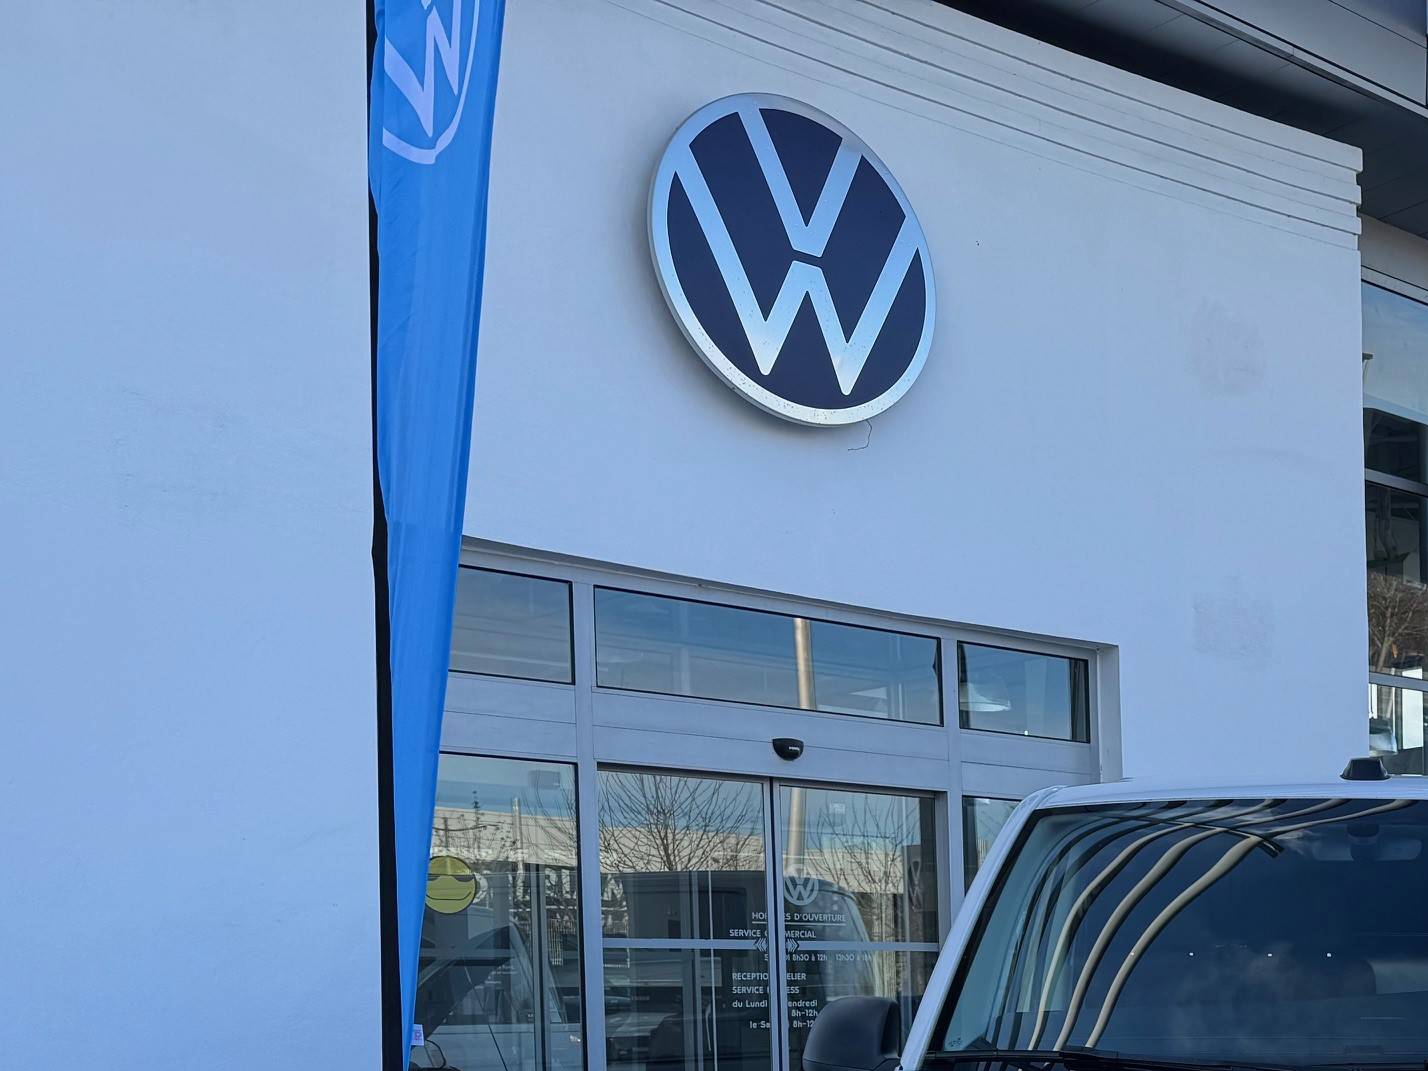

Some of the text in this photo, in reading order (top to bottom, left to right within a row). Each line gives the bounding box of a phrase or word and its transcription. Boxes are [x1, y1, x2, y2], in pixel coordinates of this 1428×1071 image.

[729, 929, 761, 937] SERVICE
[732, 972, 807, 981] RECEPTIO ELIER
[732, 986, 764, 994] SERVICE
[732, 1000, 818, 1008] du Lundi endredi
[749, 1020, 758, 1028] le
[793, 1020, 815, 1028] 8h-12
